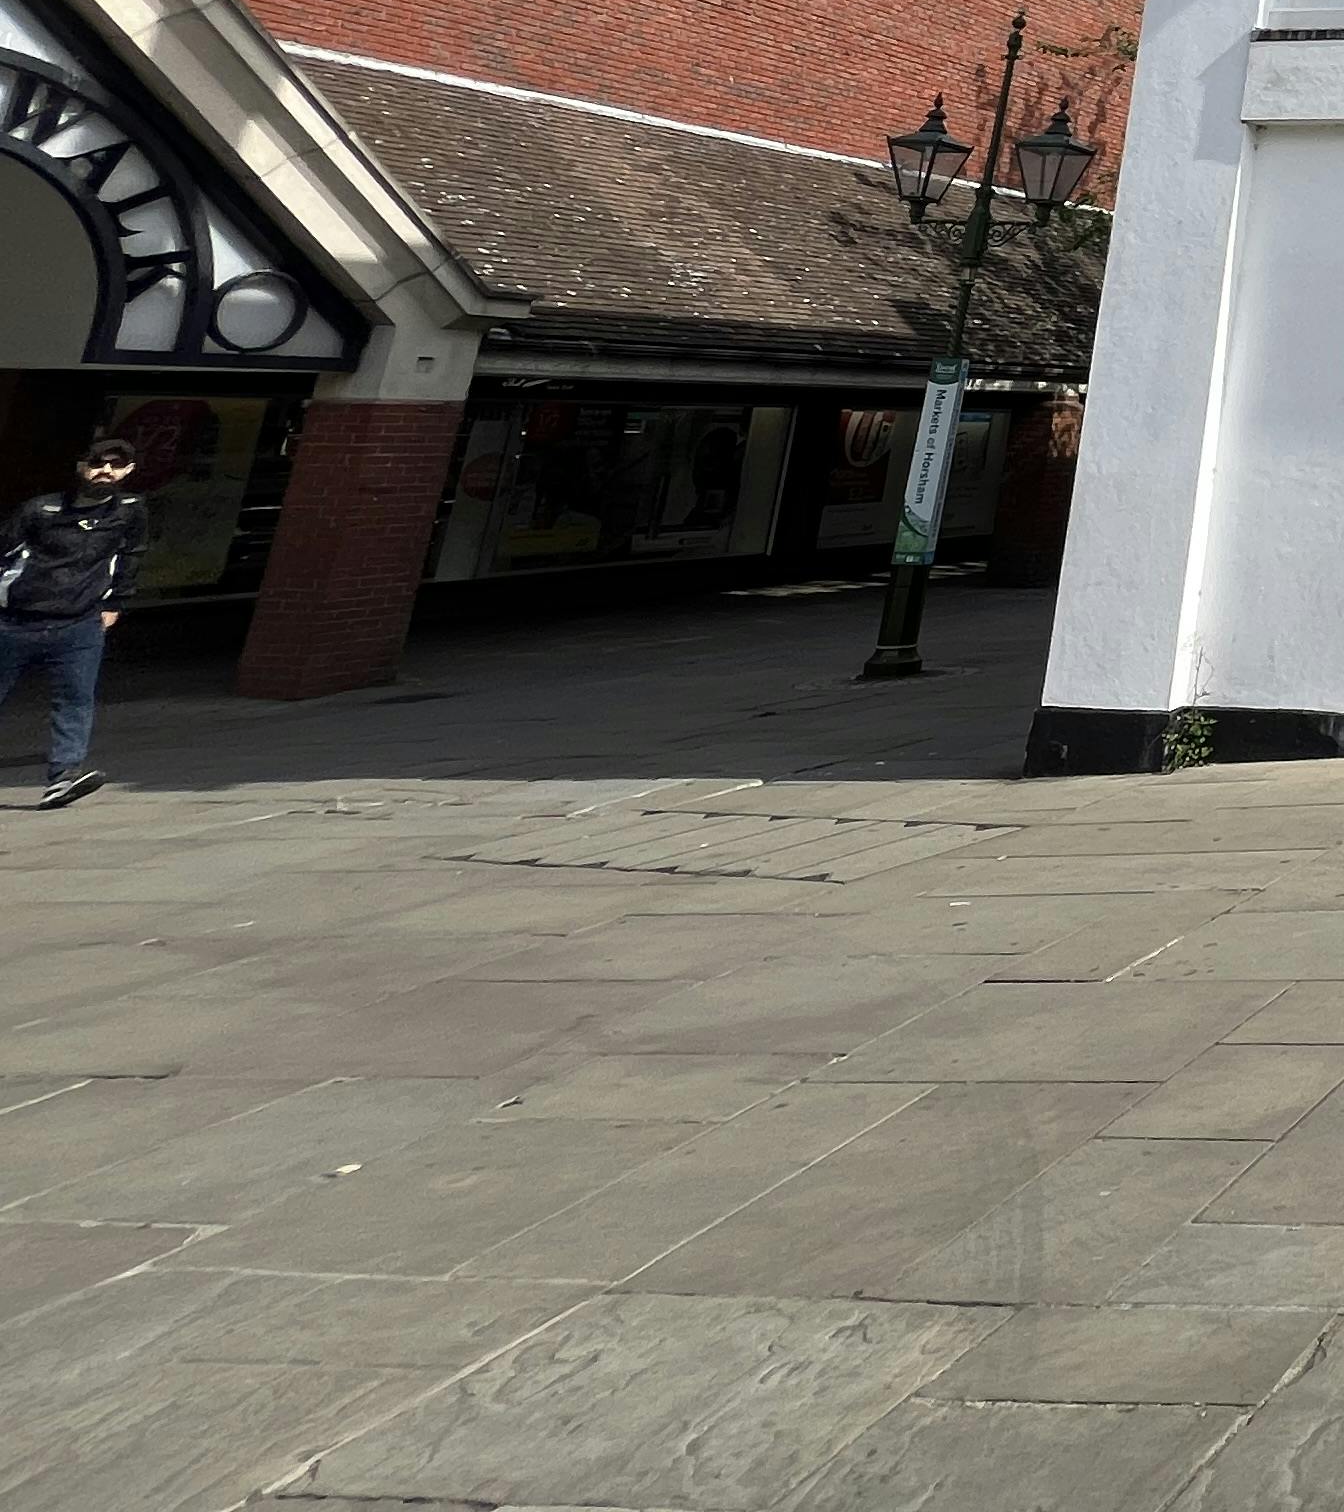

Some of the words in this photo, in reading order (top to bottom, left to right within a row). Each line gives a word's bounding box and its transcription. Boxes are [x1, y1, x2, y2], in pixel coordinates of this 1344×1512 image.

[3, 70, 191, 304] WALK
[929, 389, 947, 434] Markets
[926, 437, 936, 449] of
[914, 452, 934, 504] Horsham
